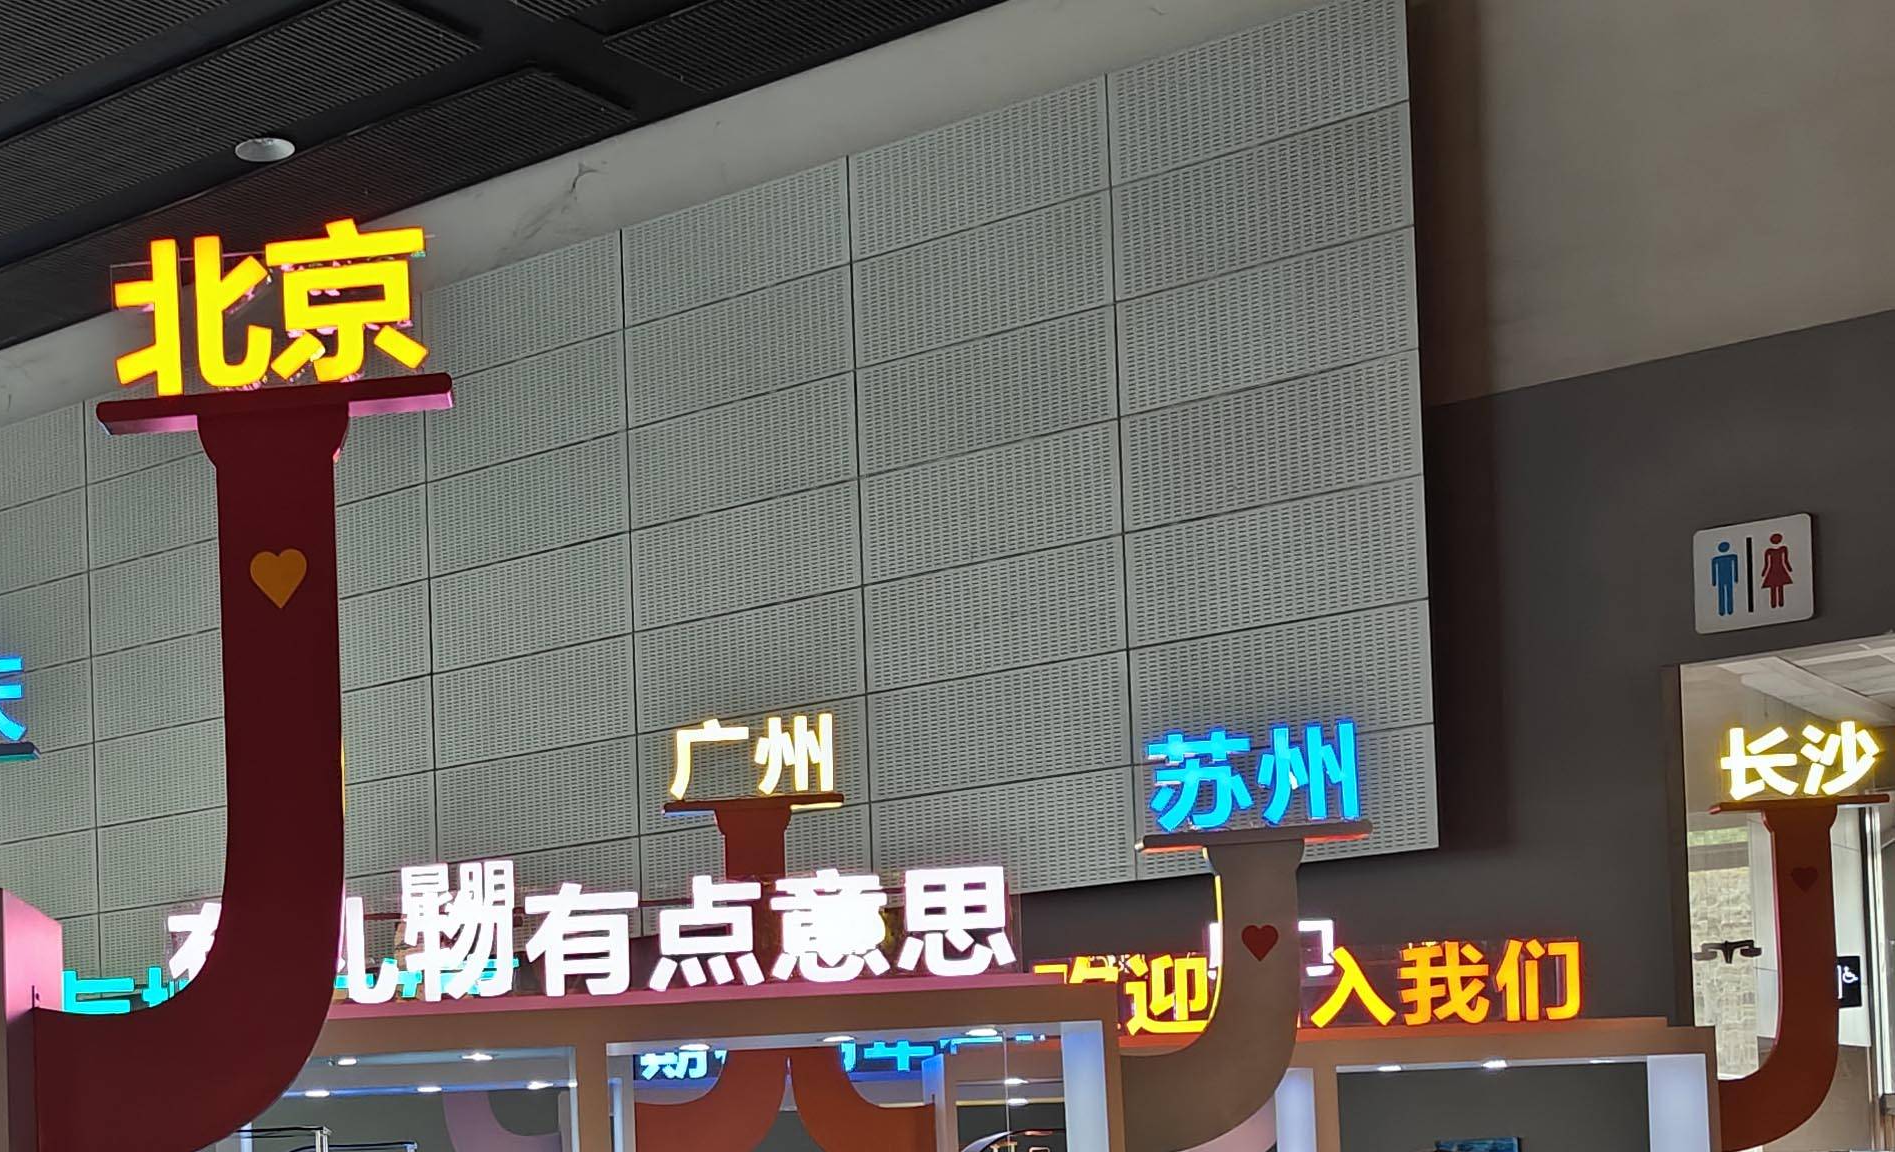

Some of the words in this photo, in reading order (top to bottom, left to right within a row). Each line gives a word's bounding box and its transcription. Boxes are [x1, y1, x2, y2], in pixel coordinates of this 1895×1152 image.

[114, 217, 430, 397] 北京
[669, 712, 835, 801] 广州
[1147, 719, 1361, 832] 苏州
[1719, 720, 1882, 801] 长沙
